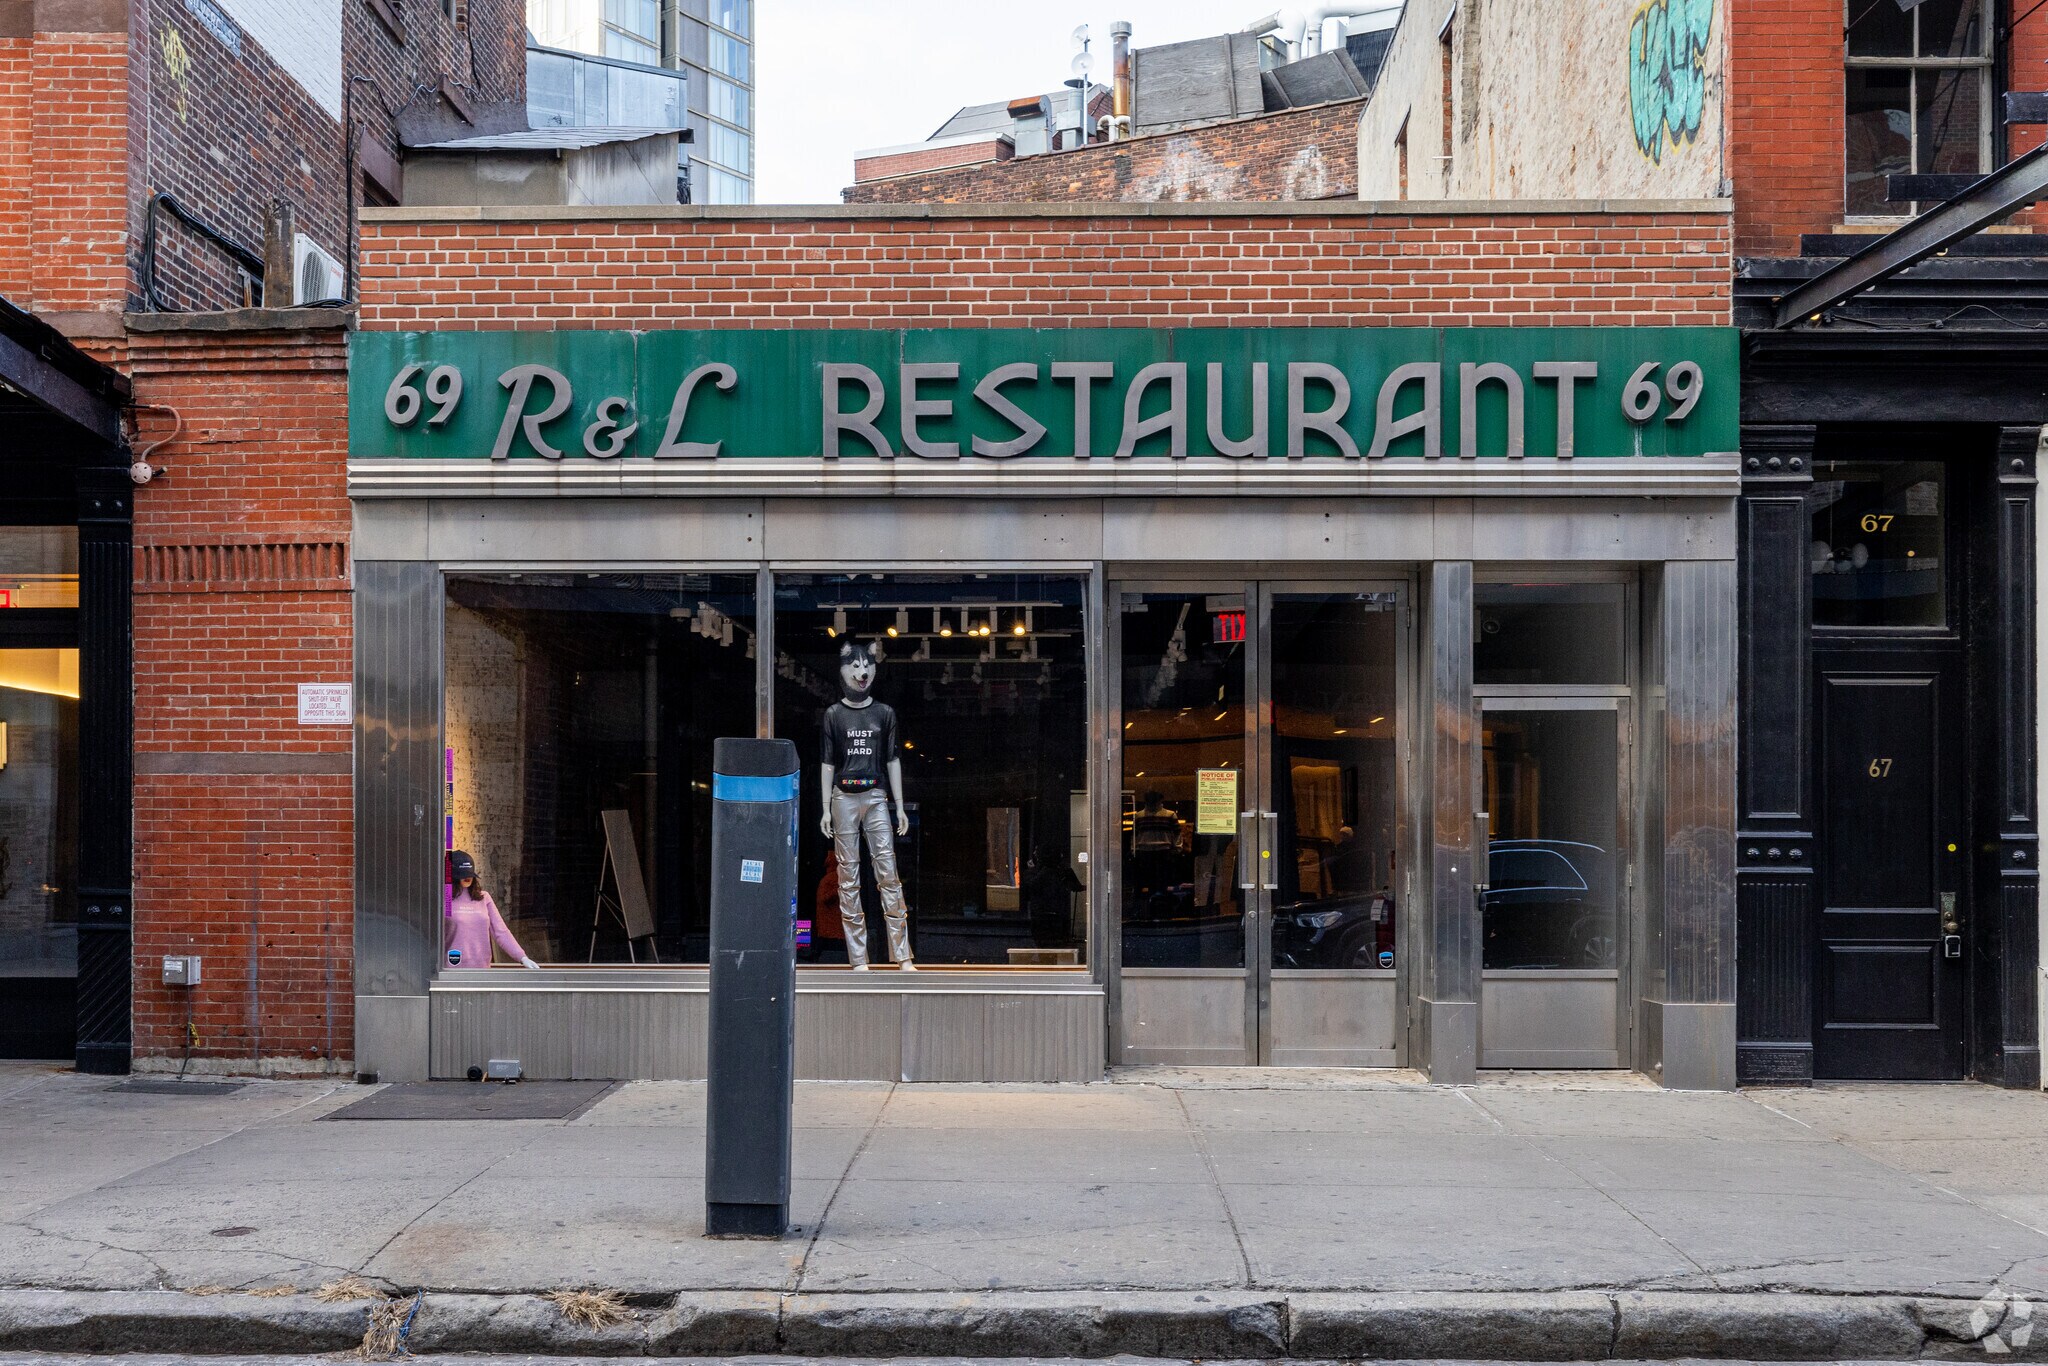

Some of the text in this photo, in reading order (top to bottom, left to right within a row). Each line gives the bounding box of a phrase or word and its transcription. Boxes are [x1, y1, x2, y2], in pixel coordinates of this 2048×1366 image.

[385, 365, 463, 426] 69
[823, 360, 1597, 457] RESTAURANT
[1622, 361, 1704, 422] 69
[1861, 514, 1894, 532] 67
[847, 730, 873, 738] MUST
[1869, 758, 1893, 778] 67
